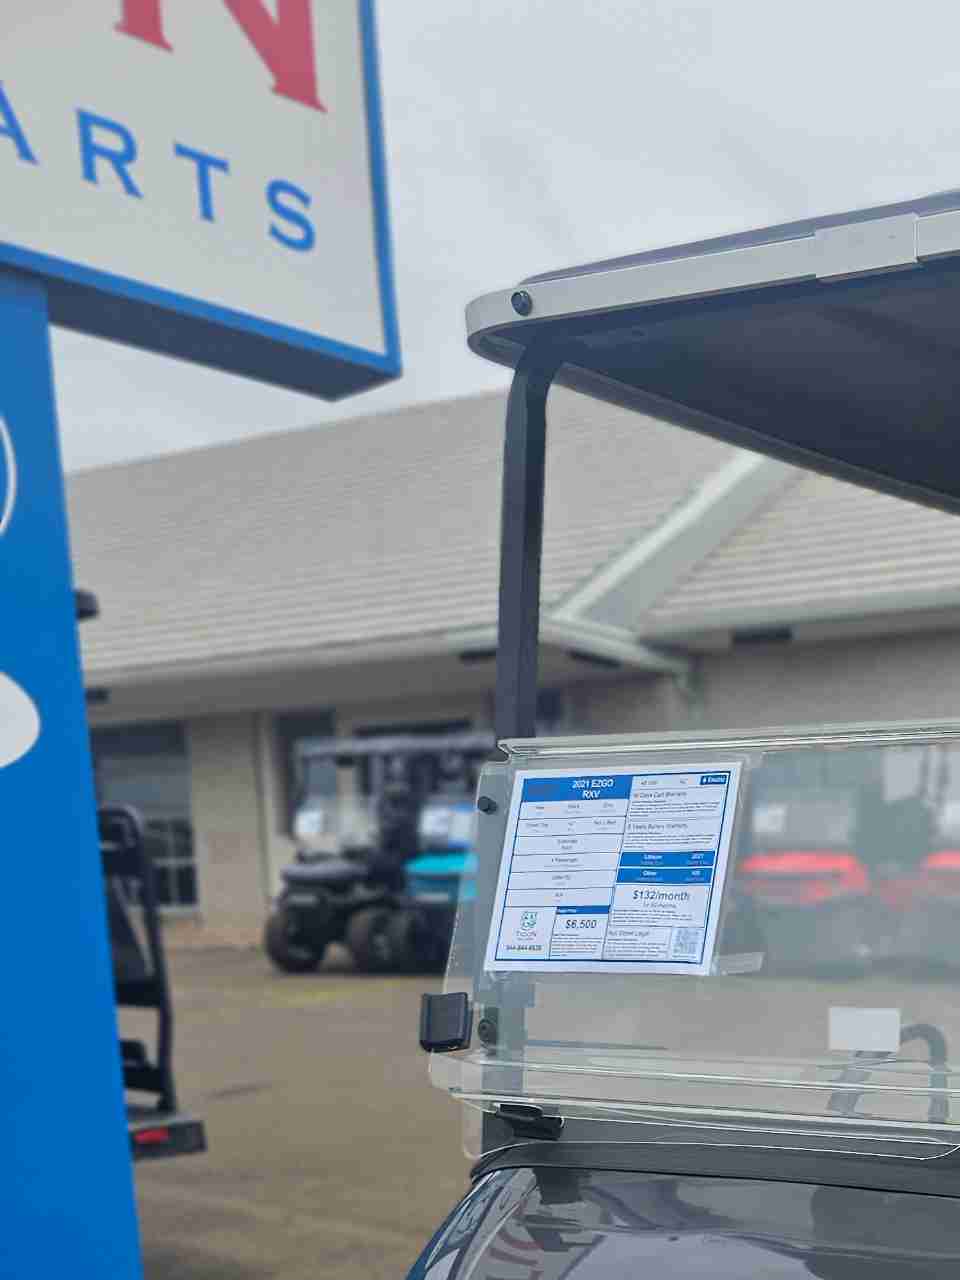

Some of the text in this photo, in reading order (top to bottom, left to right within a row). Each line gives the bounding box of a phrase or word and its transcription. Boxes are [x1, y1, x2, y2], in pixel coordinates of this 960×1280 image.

[572, 778, 615, 789] 2021 EZGO
[582, 789, 601, 799] RXV
[632, 889, 690, 902] $132/month
[565, 919, 597, 930] $6,500
